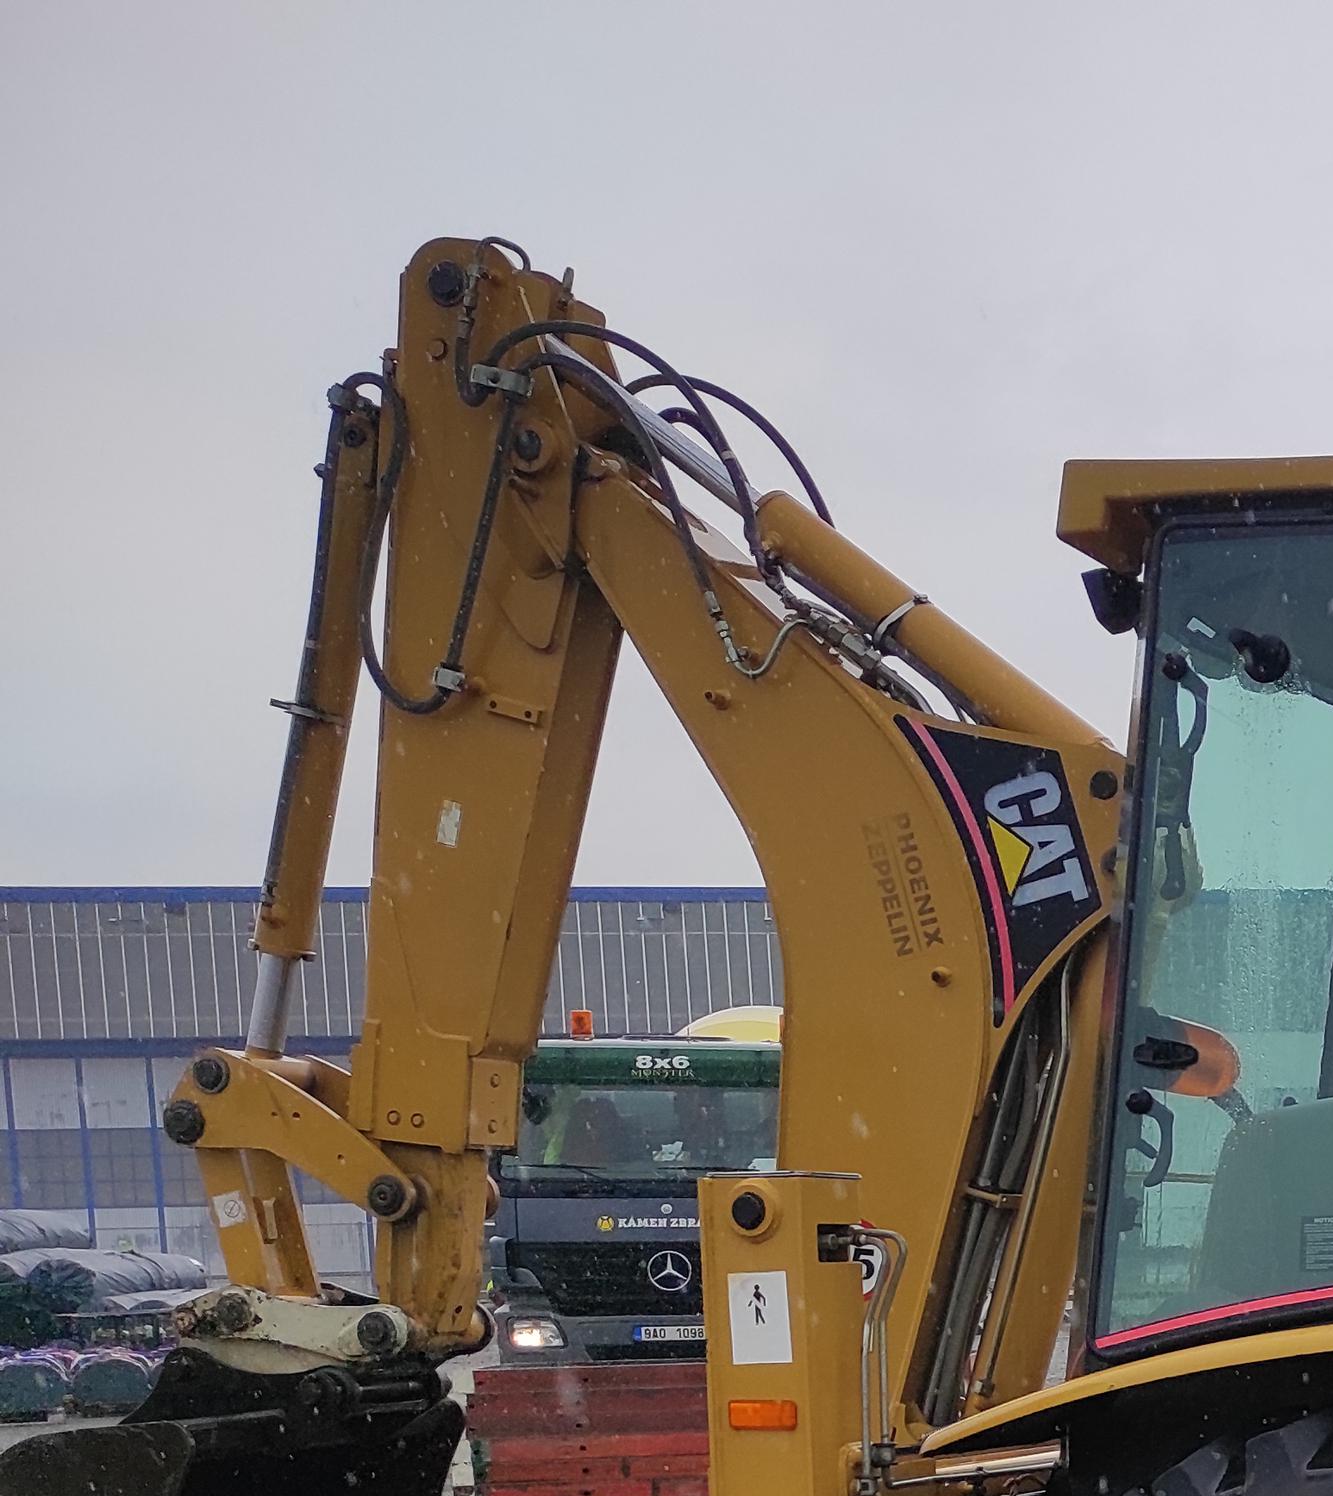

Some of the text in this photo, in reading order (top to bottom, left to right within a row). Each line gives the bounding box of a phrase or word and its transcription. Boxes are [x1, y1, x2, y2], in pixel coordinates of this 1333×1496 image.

[861, 820, 914, 957] ZEPPELIN
[894, 812, 944, 948] PHOENIX
[984, 771, 1089, 907] CAT
[635, 1055, 690, 1069] 8x6
